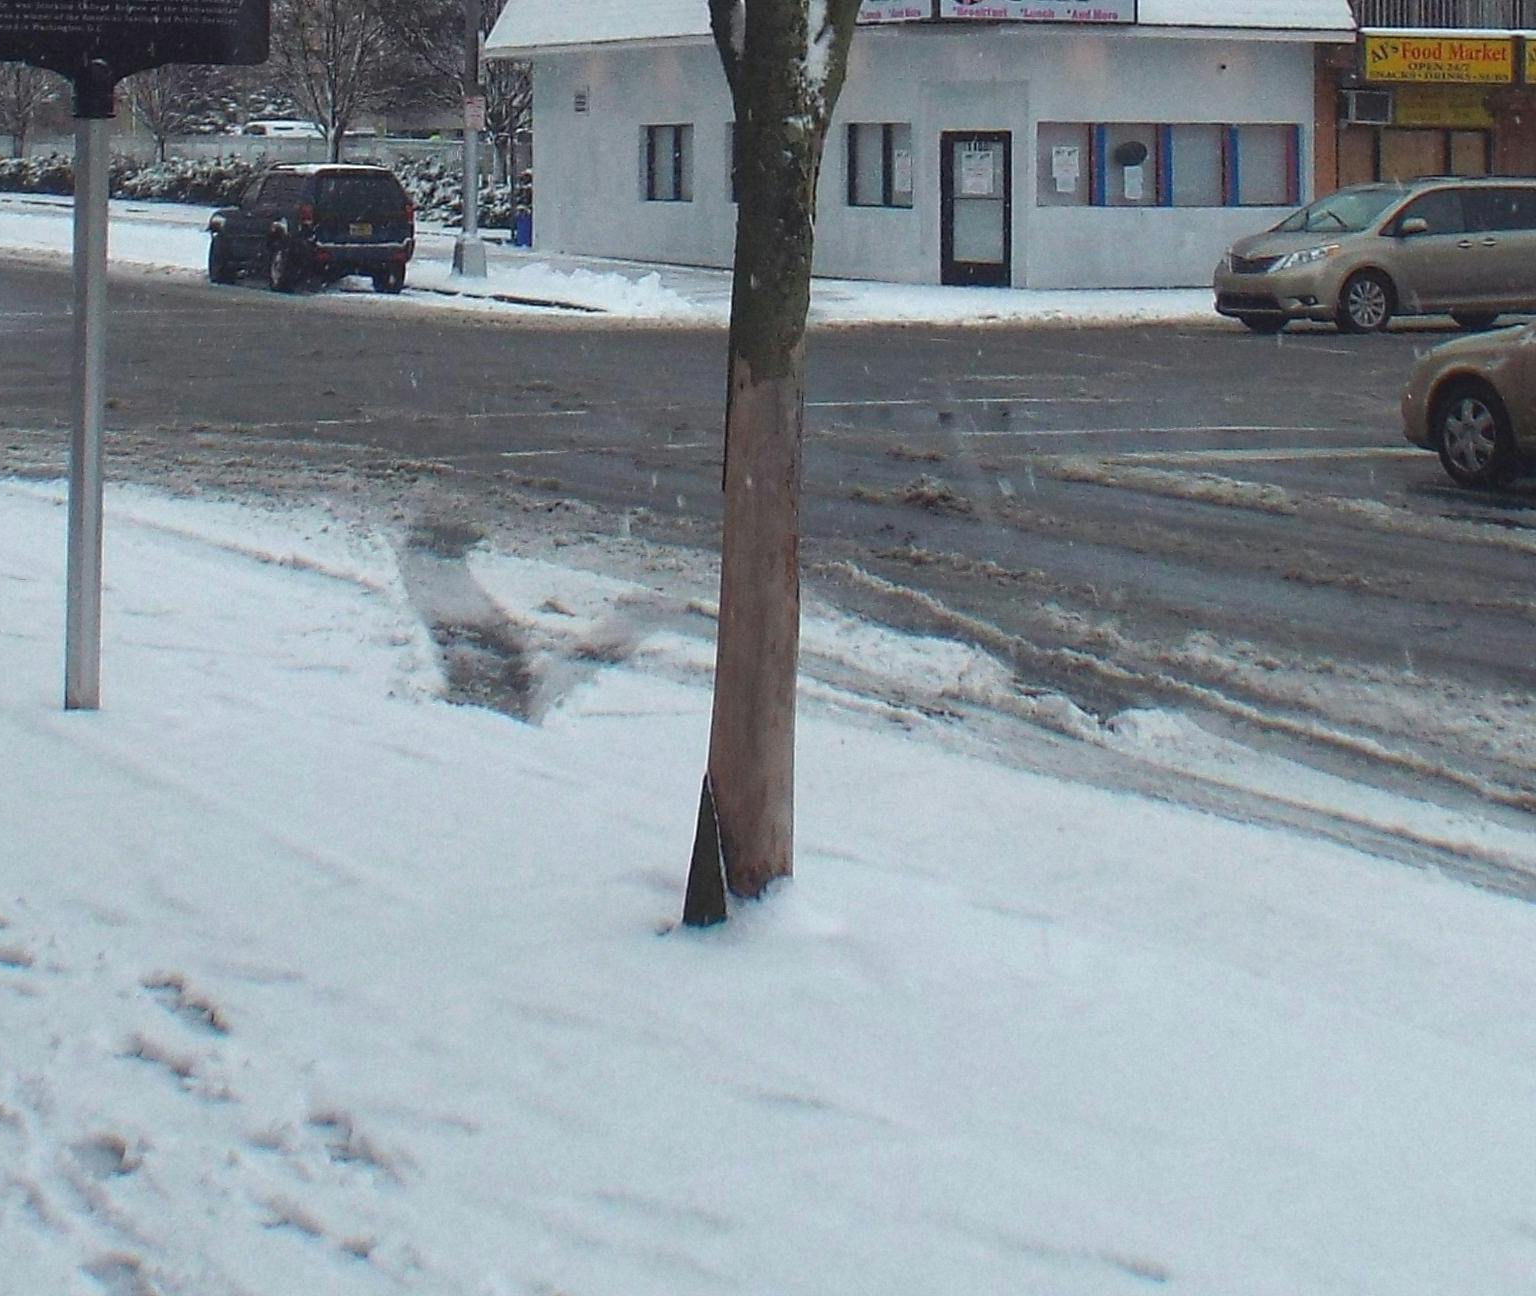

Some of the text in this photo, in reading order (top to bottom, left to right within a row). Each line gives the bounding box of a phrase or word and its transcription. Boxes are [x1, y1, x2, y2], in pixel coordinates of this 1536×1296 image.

[1399, 41, 1443, 60] Food
[1449, 42, 1506, 62] Market
[1407, 62, 1443, 72] OPEN
